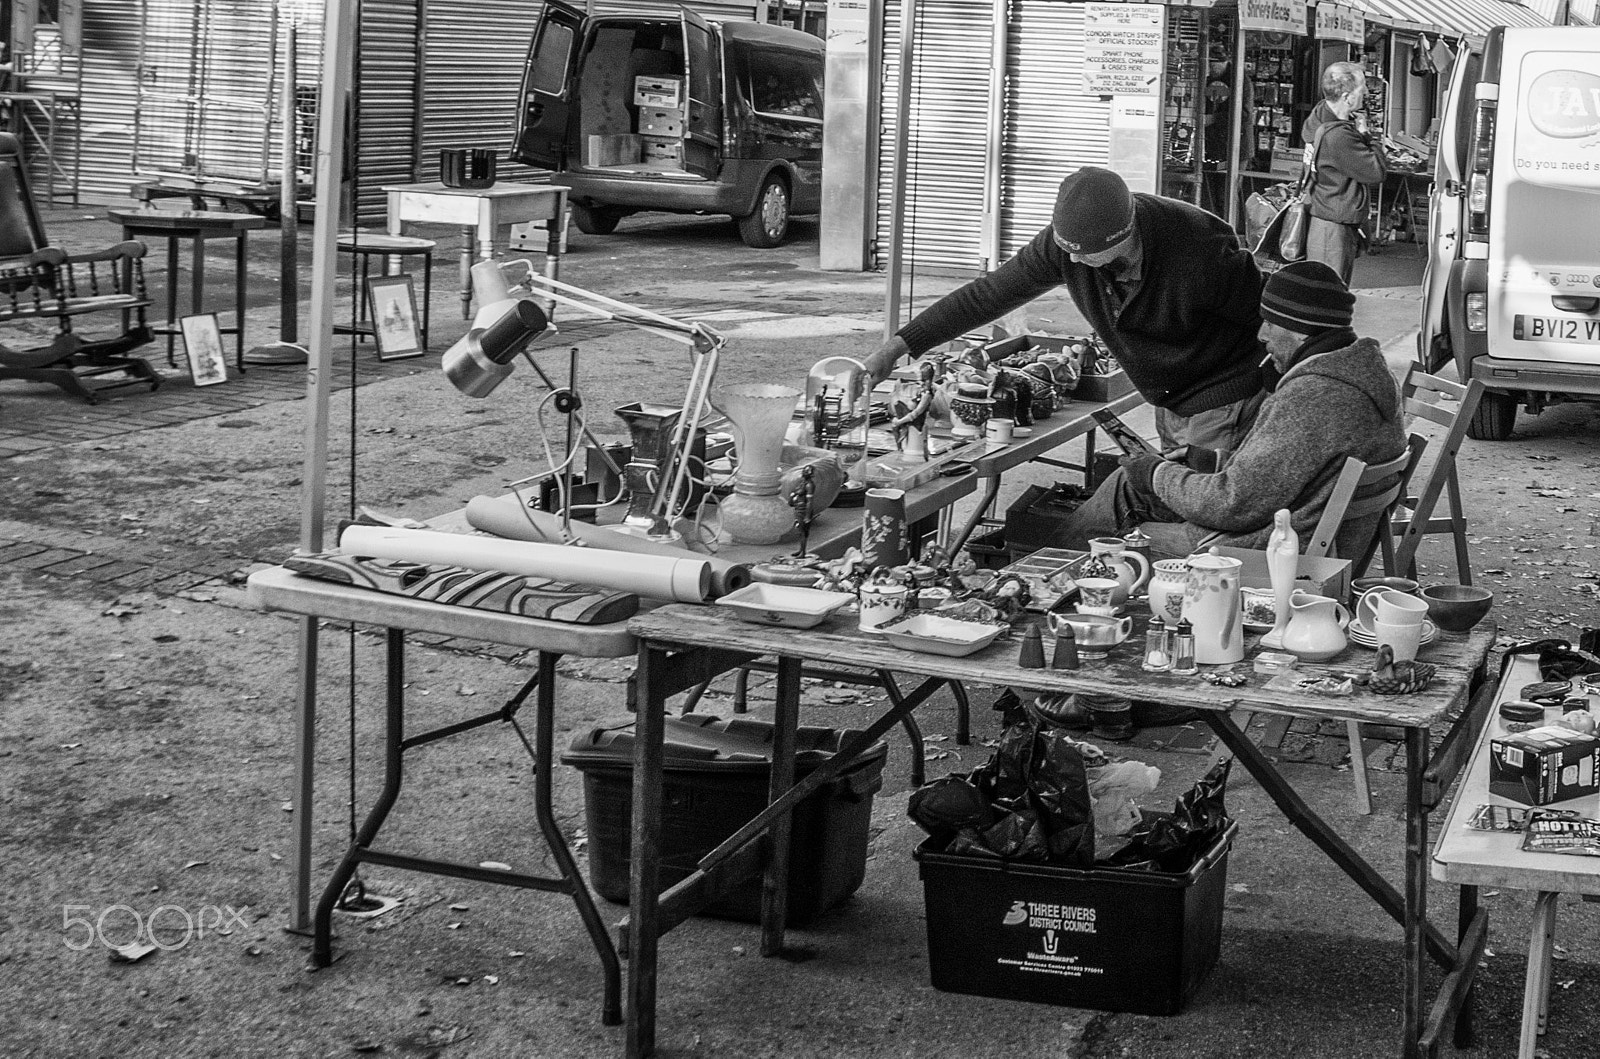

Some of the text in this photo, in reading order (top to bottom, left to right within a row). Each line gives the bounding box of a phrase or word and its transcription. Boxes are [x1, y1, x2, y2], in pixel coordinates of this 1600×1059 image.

[1517, 159, 1531, 168] Do
[1536, 161, 1557, 170] you
[1561, 161, 1590, 171] need
[1532, 318, 1600, 341] BV12 V
[1027, 902, 1060, 918] THREE
[1061, 905, 1097, 922] RIVERS
[1029, 916, 1097, 933] DISTRICT COUNCIL
